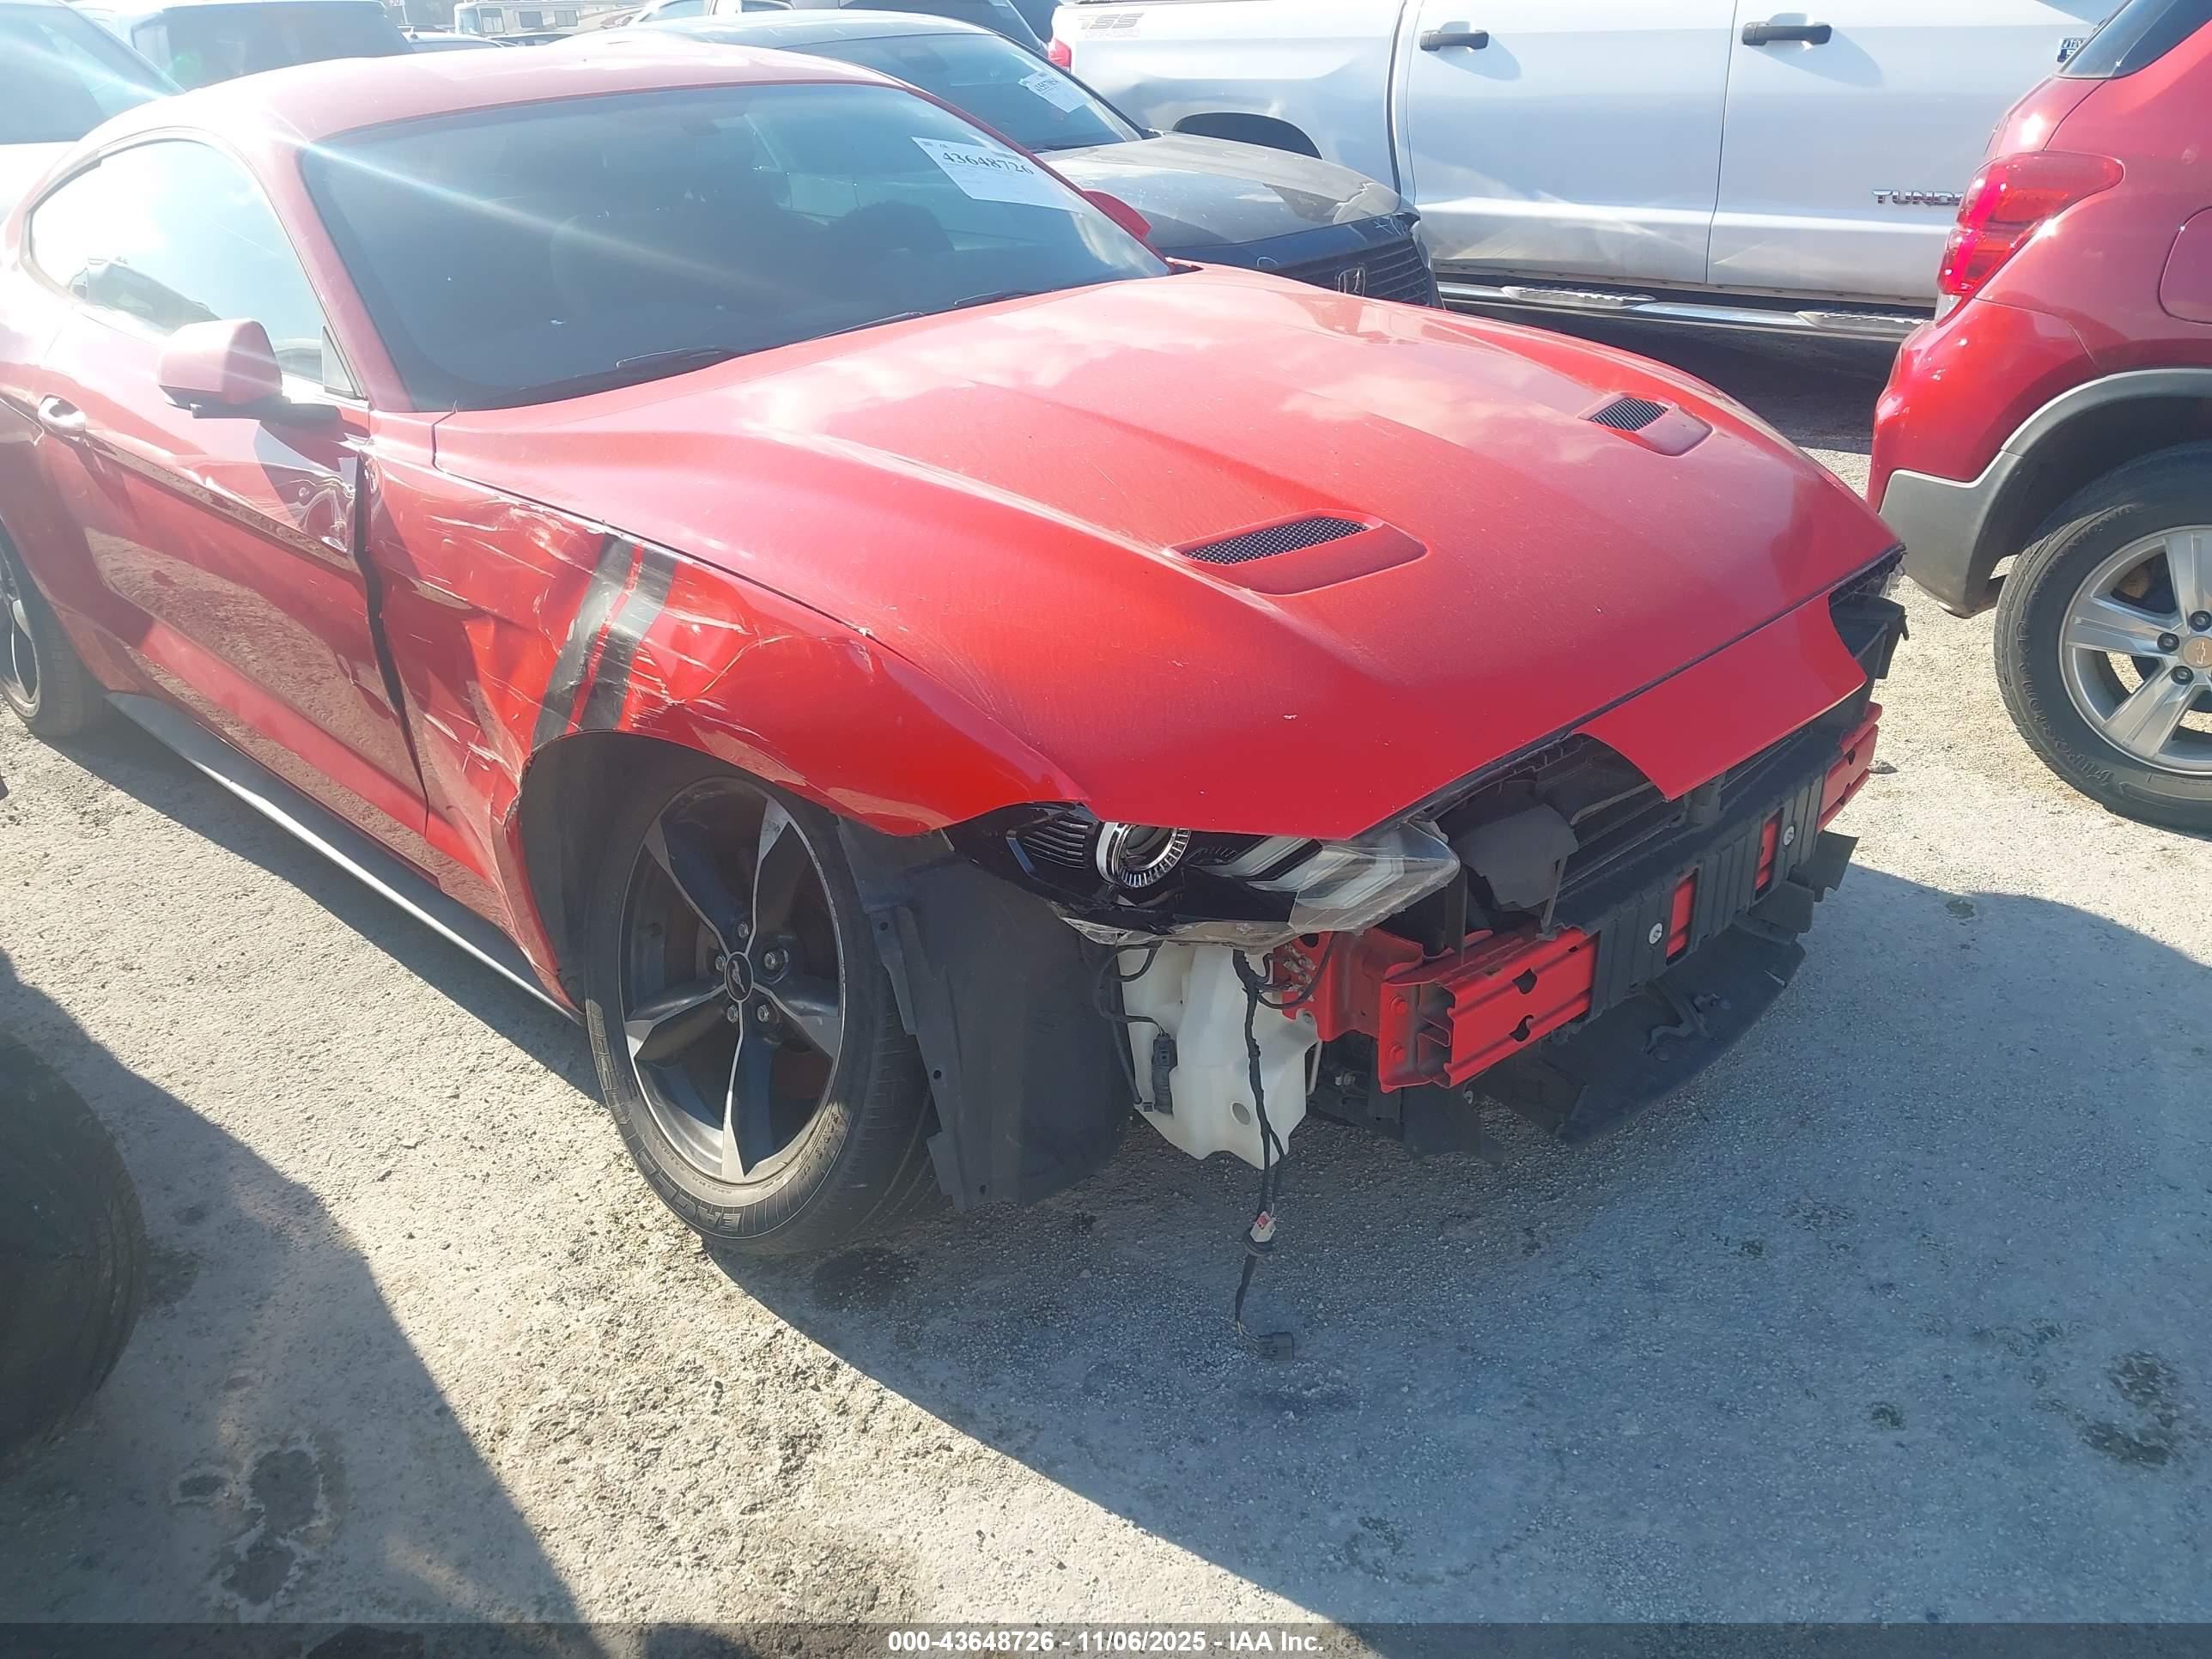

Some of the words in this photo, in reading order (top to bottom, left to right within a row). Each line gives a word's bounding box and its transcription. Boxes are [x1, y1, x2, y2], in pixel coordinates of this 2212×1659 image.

[1079, 12, 1145, 29] TSS
[943, 152, 1034, 175] 43648726
[634, 1146, 742, 1232] EAGLE
